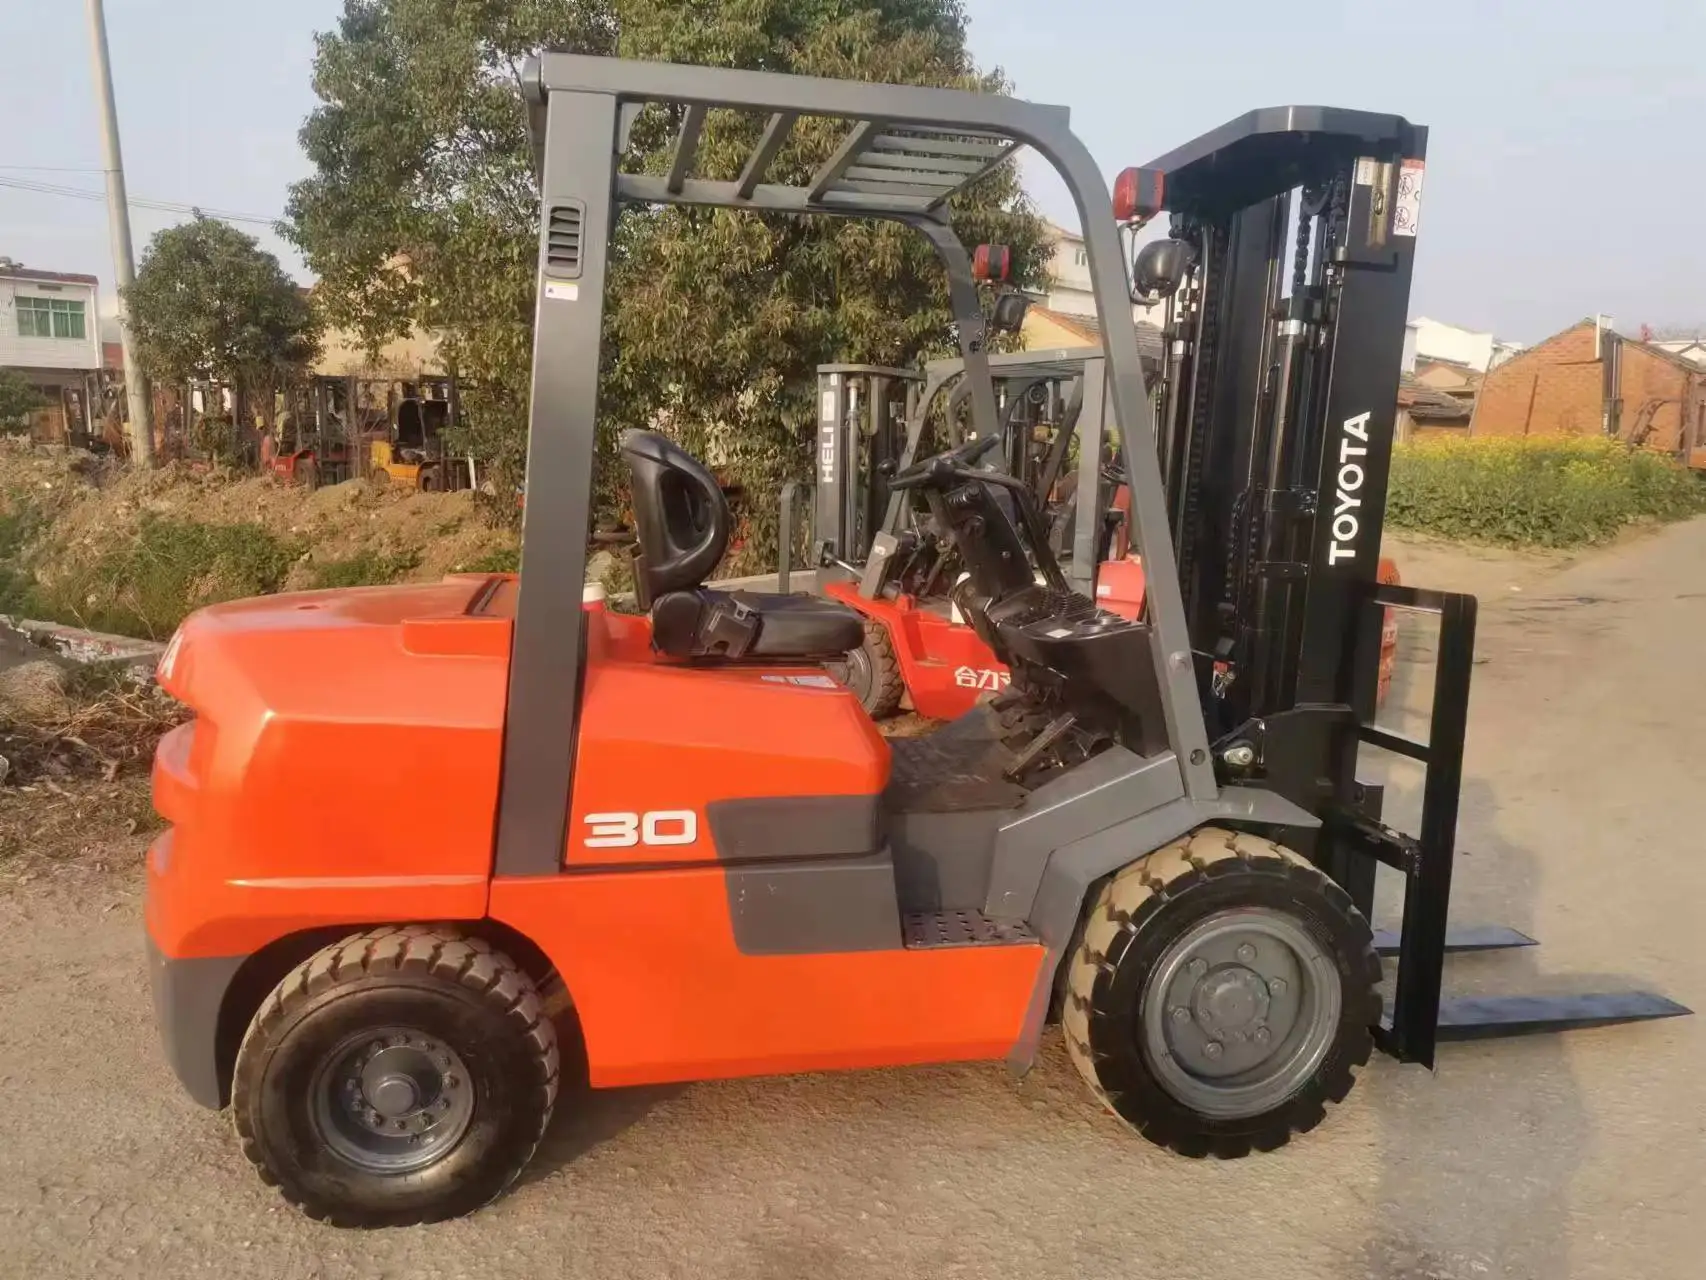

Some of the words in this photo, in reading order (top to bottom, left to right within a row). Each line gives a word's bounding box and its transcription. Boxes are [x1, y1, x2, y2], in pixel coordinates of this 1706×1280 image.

[822, 426, 834, 483] HELI
[1328, 411, 1371, 566] TOYOTA
[583, 809, 697, 848] 30
